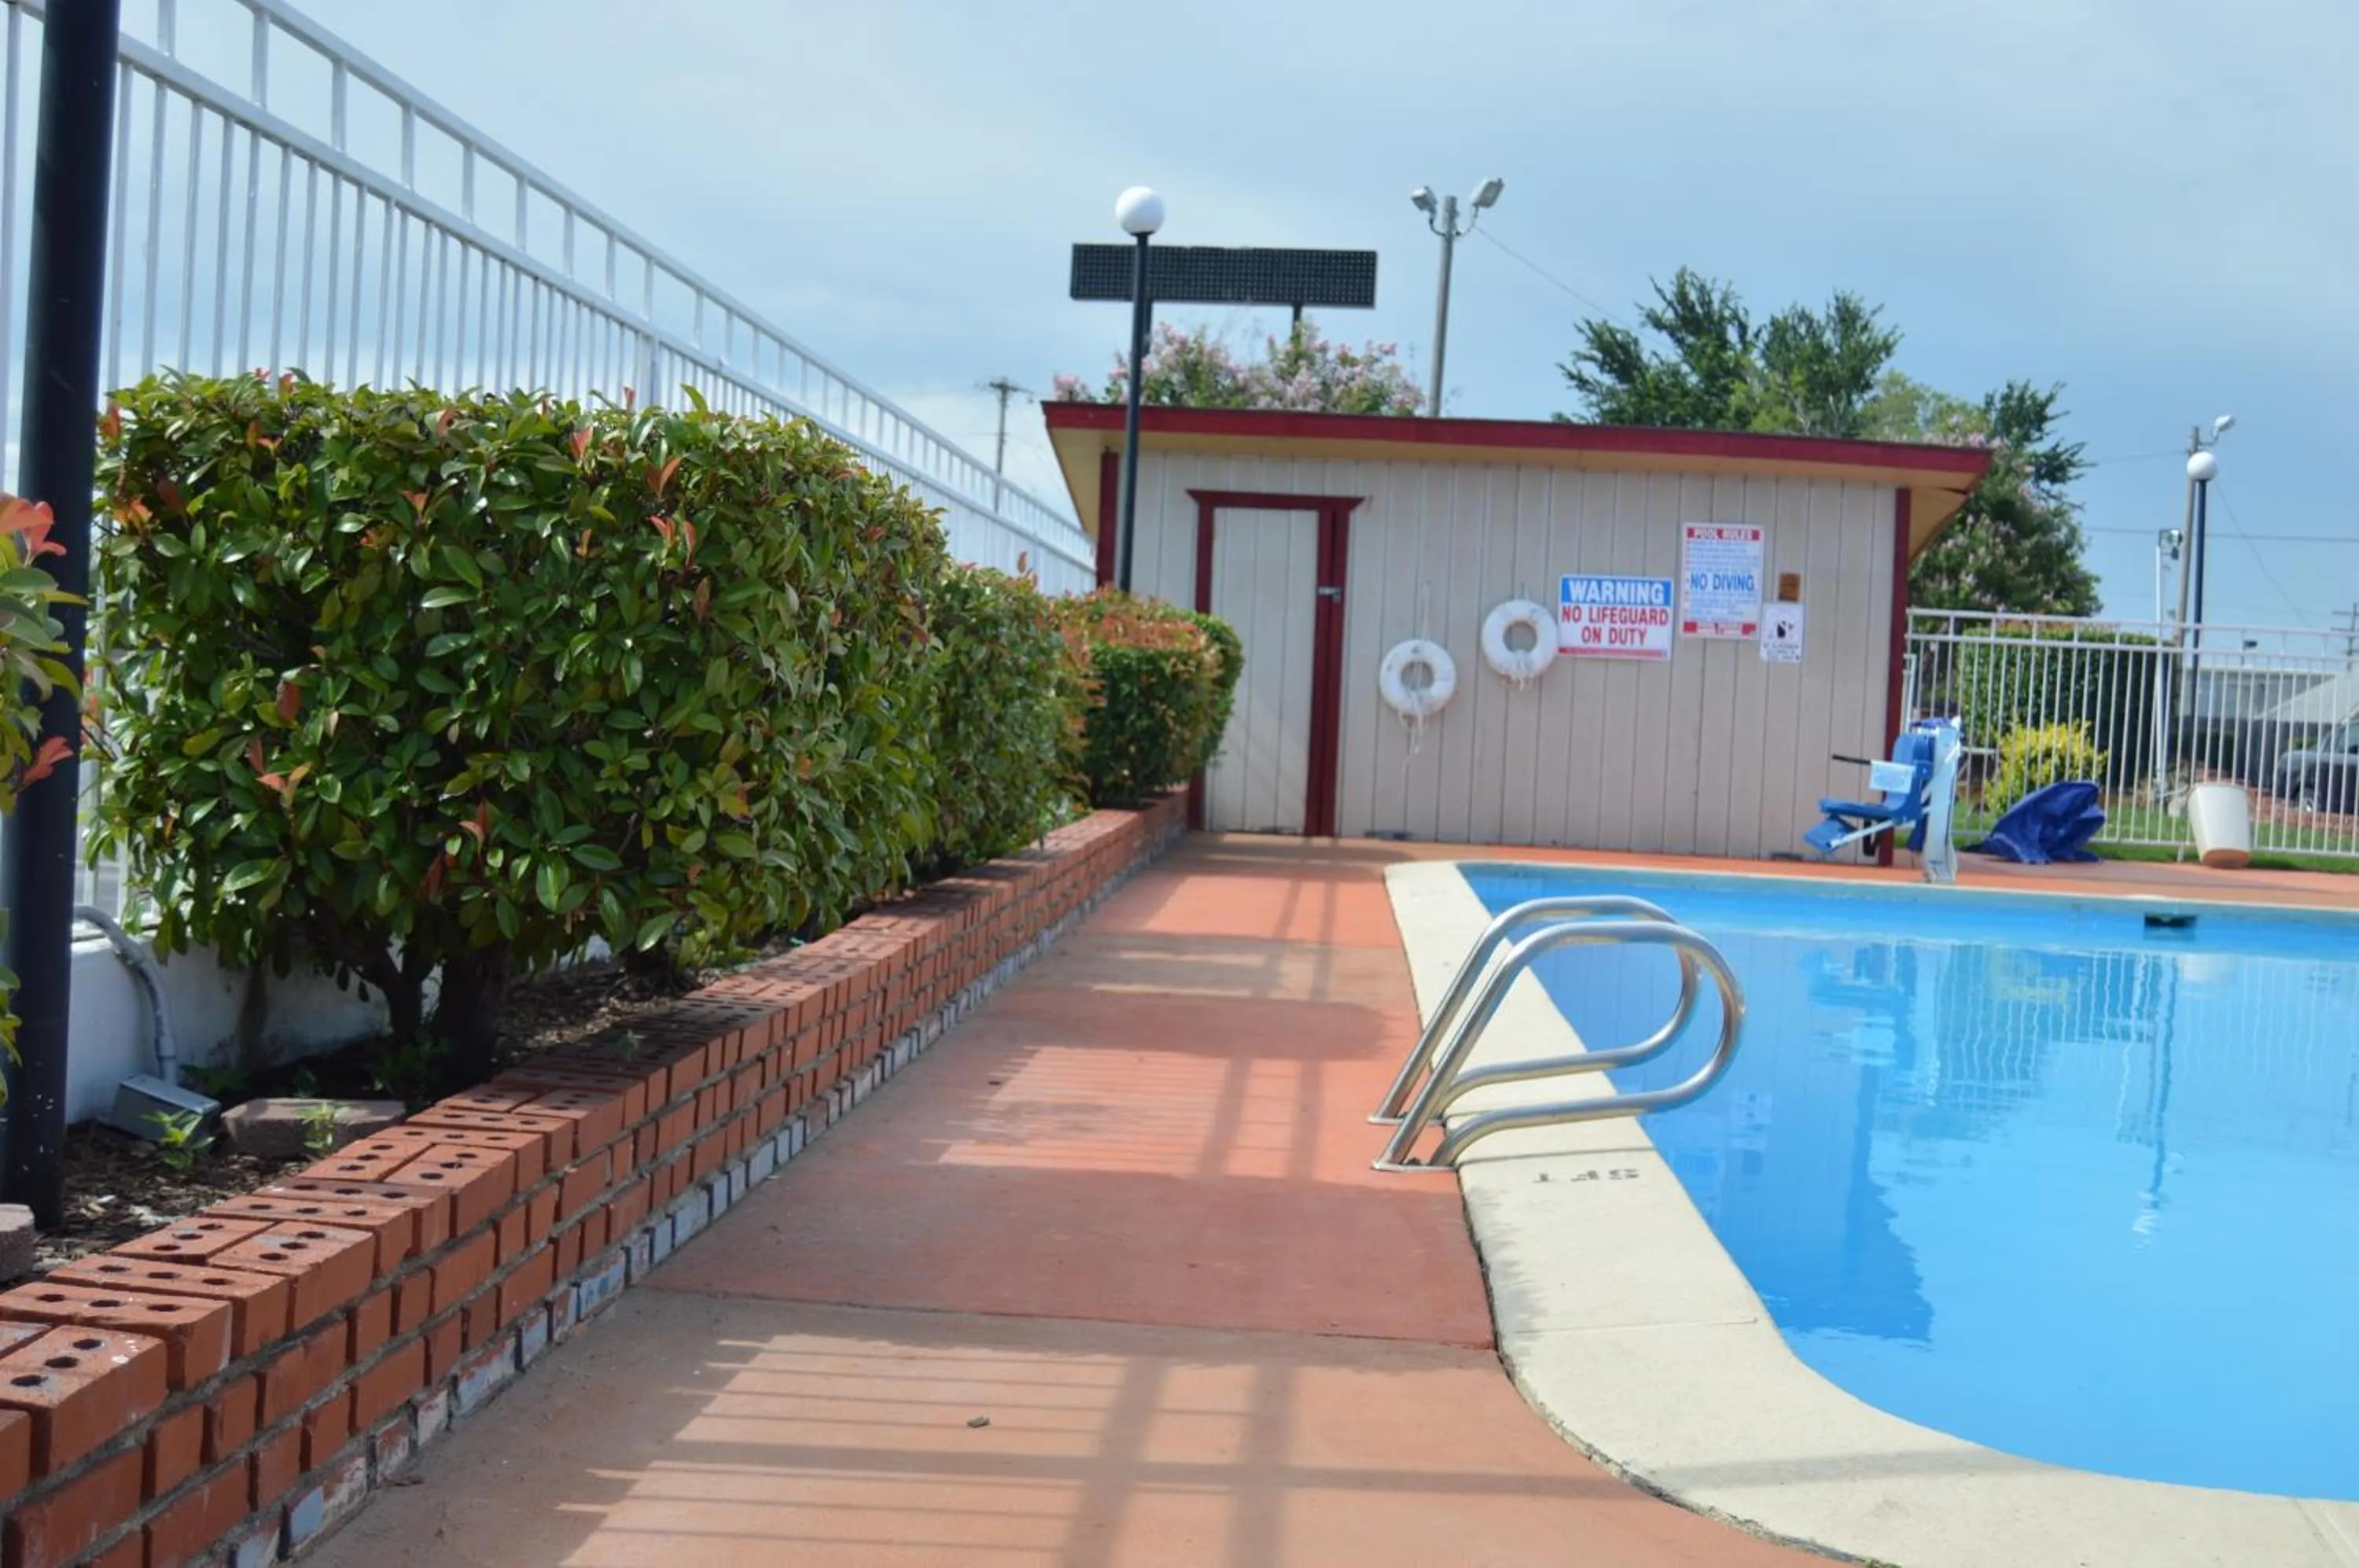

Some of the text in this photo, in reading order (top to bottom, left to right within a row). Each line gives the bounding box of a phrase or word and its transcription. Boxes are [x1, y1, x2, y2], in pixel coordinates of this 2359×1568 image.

[1691, 572, 1754, 591] NO DIVING
[1568, 579, 1665, 605] WARNING
[1561, 605, 1582, 623] NO
[1588, 605, 1669, 627] LIFEGUARD
[1581, 626, 1647, 645] ON DUTY
